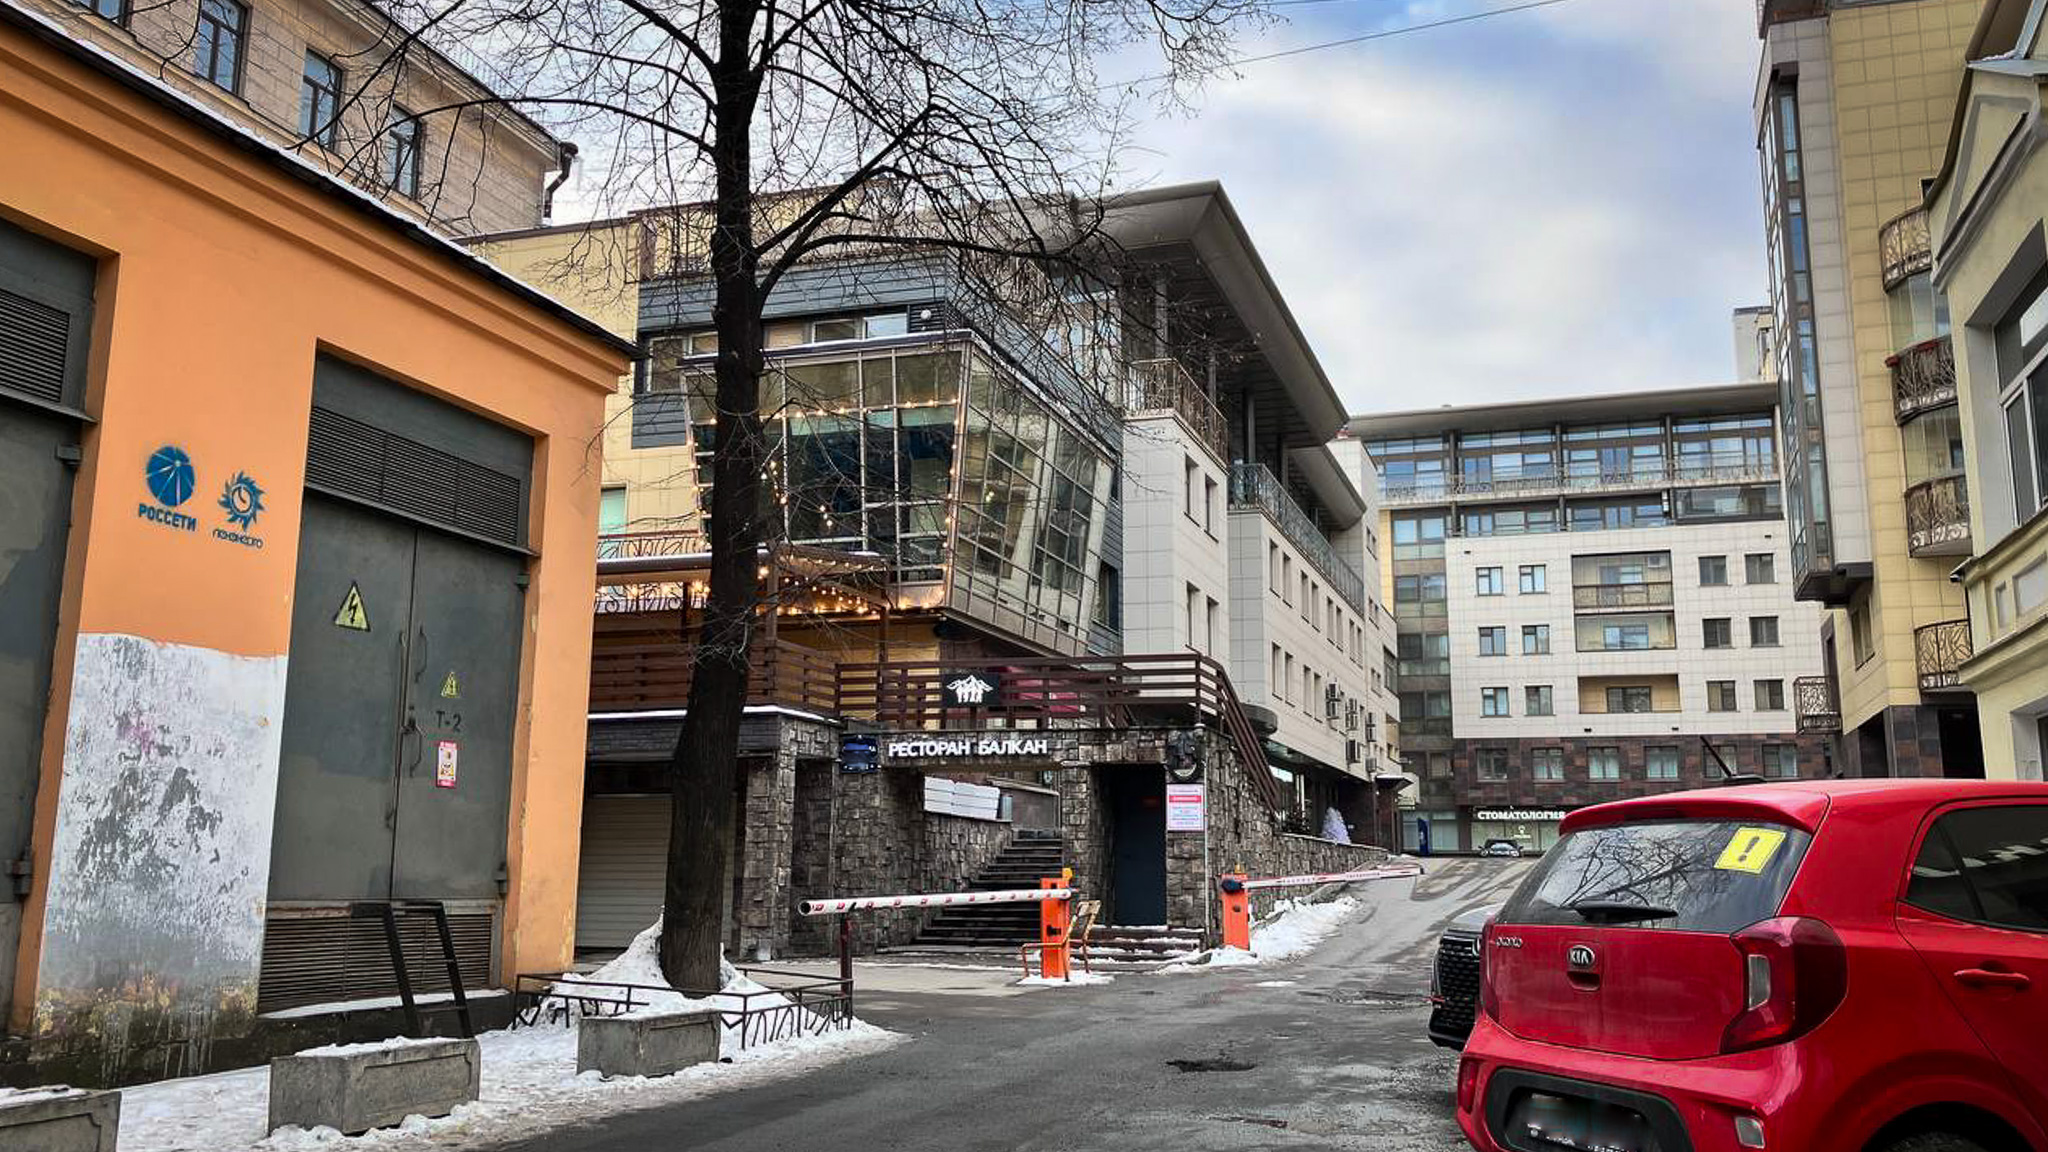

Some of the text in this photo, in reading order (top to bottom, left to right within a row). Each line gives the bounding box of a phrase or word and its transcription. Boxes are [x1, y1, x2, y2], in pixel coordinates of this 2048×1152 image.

[138, 503, 197, 532] РОССЕТИ
[888, 741, 970, 758] РЕСТОРАН
[978, 739, 1047, 756] БАЛКАН
[1477, 811, 1566, 820] СТОМАТОЛОГИЯ
